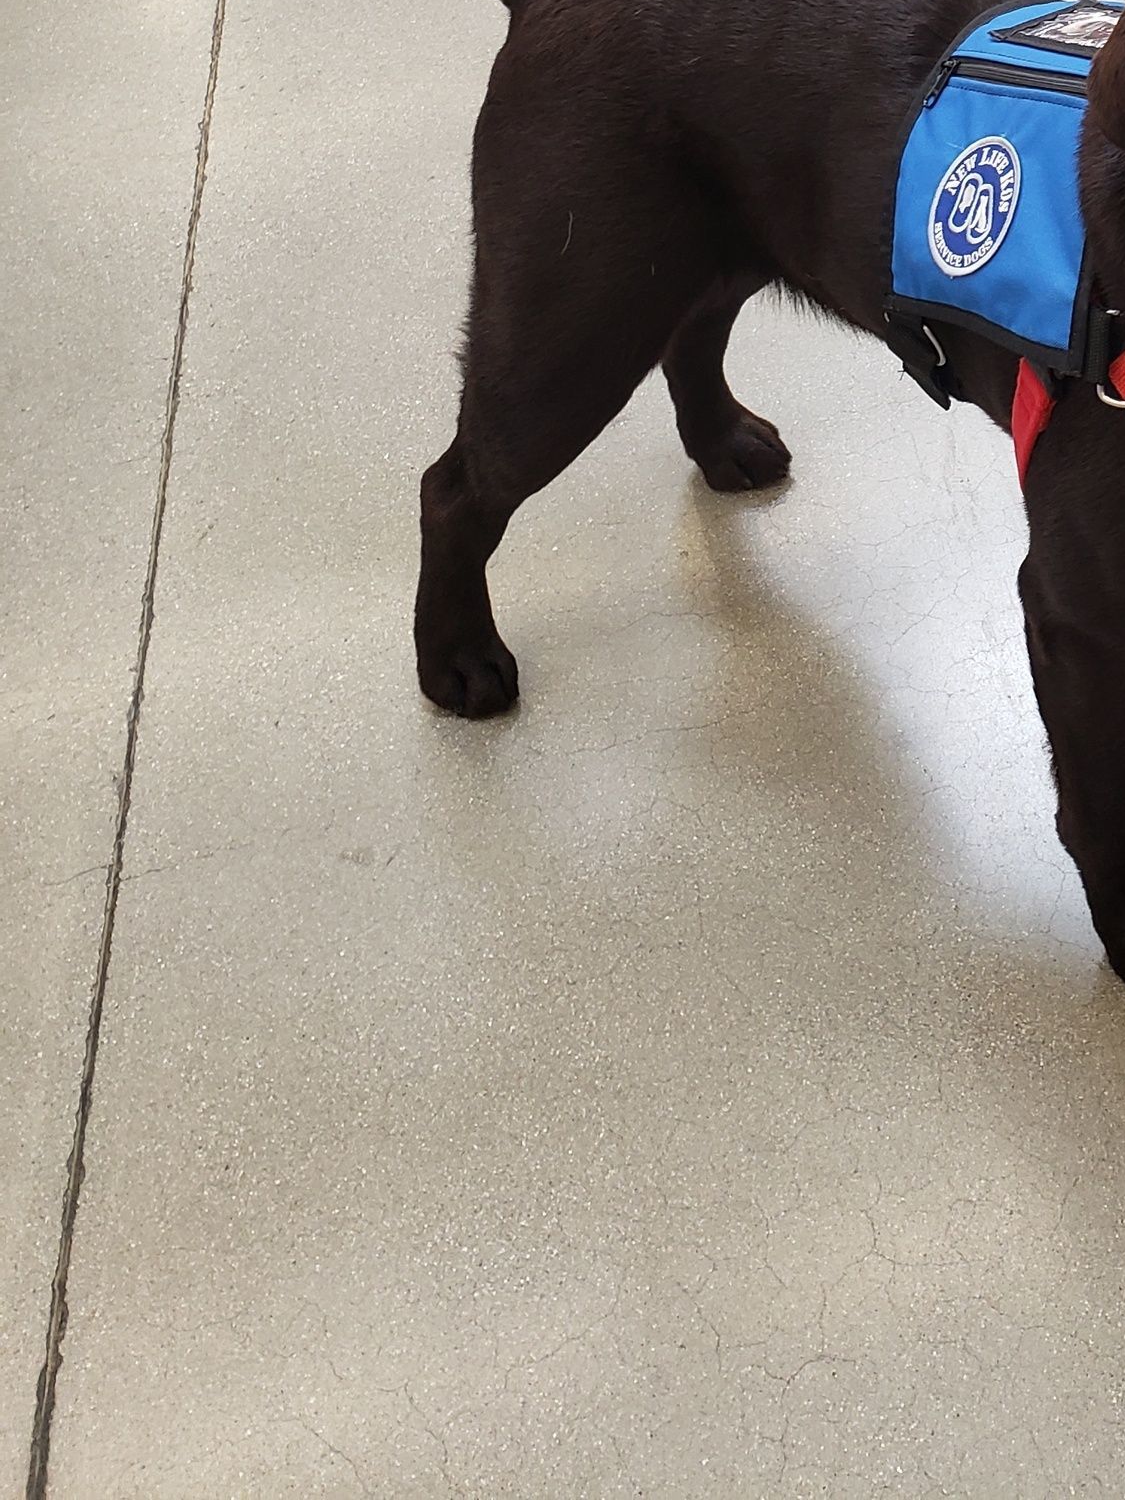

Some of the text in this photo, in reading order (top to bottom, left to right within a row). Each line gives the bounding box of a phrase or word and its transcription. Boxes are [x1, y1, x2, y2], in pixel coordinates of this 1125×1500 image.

[944, 154, 978, 196] NEW
[978, 147, 1009, 175] LIFE
[934, 221, 994, 267] SERVICE DOGS
